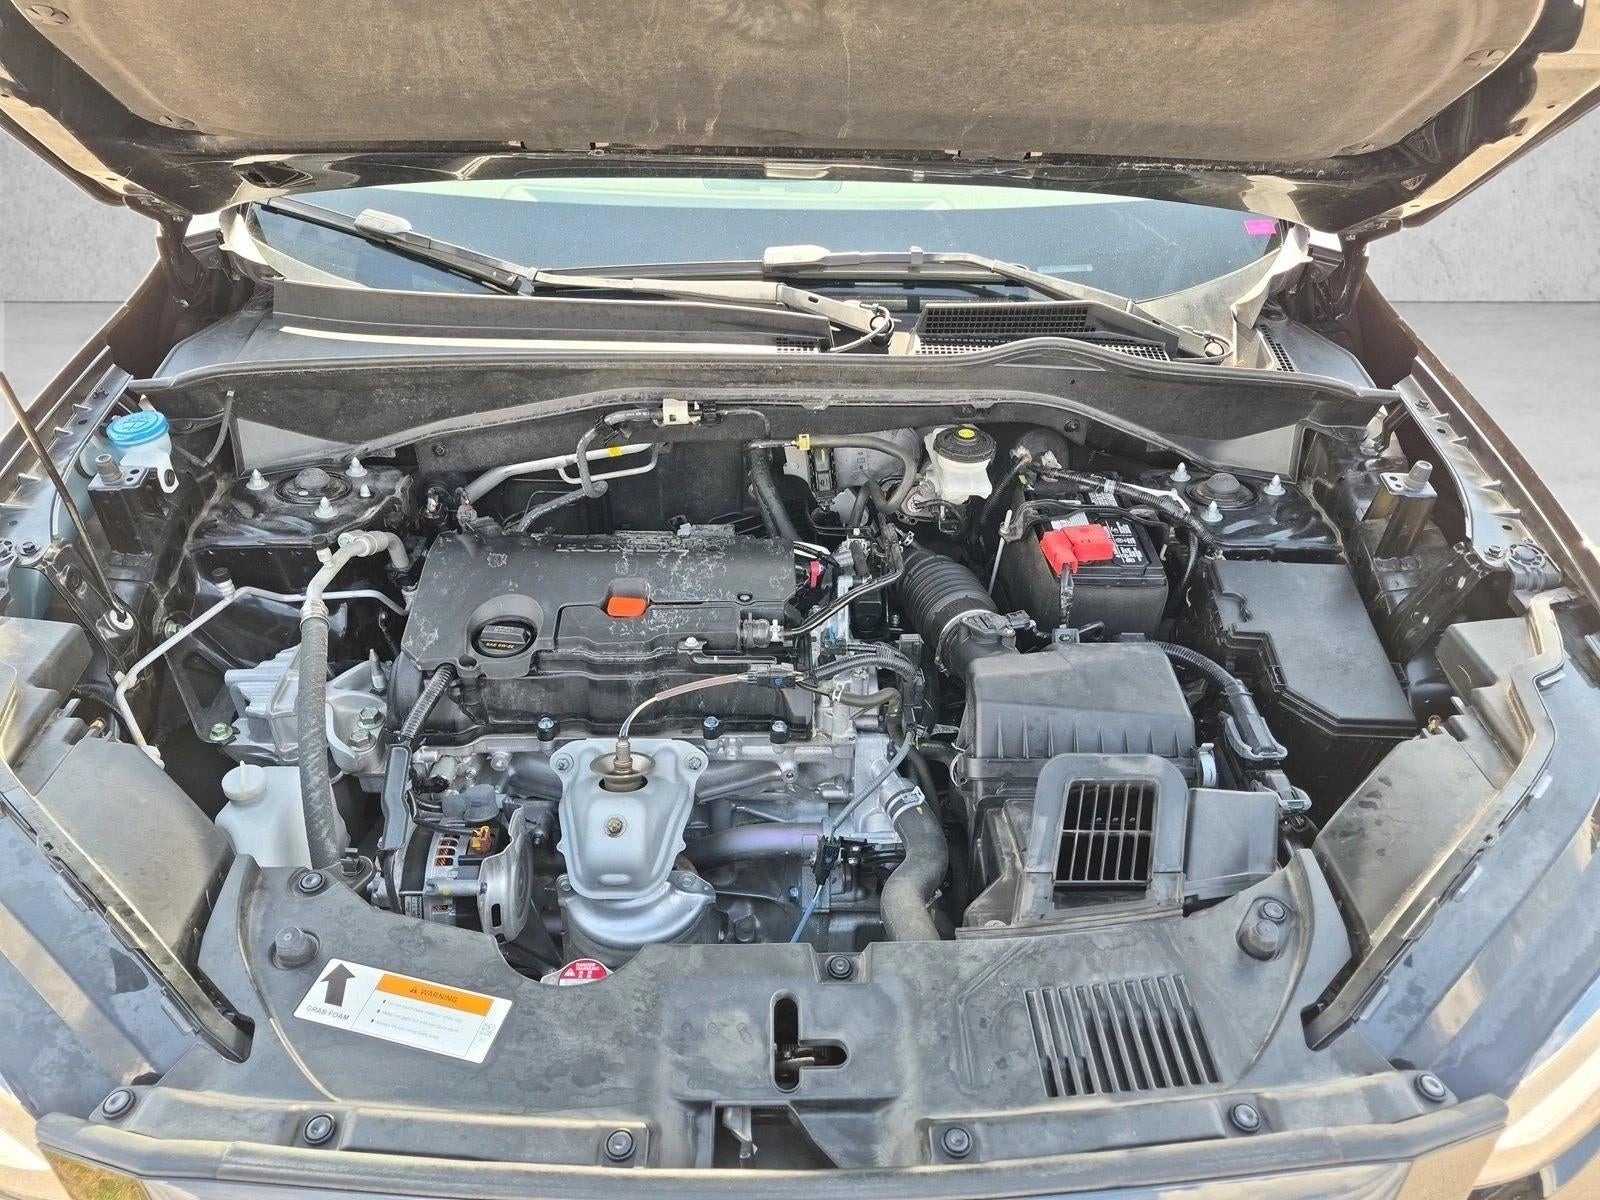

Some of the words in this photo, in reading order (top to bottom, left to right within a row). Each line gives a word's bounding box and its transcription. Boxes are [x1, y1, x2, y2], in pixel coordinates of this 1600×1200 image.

[420, 989, 458, 1003] WARNING
[306, 1004, 328, 1015] GRAB
[327, 1010, 350, 1021] FOAM
